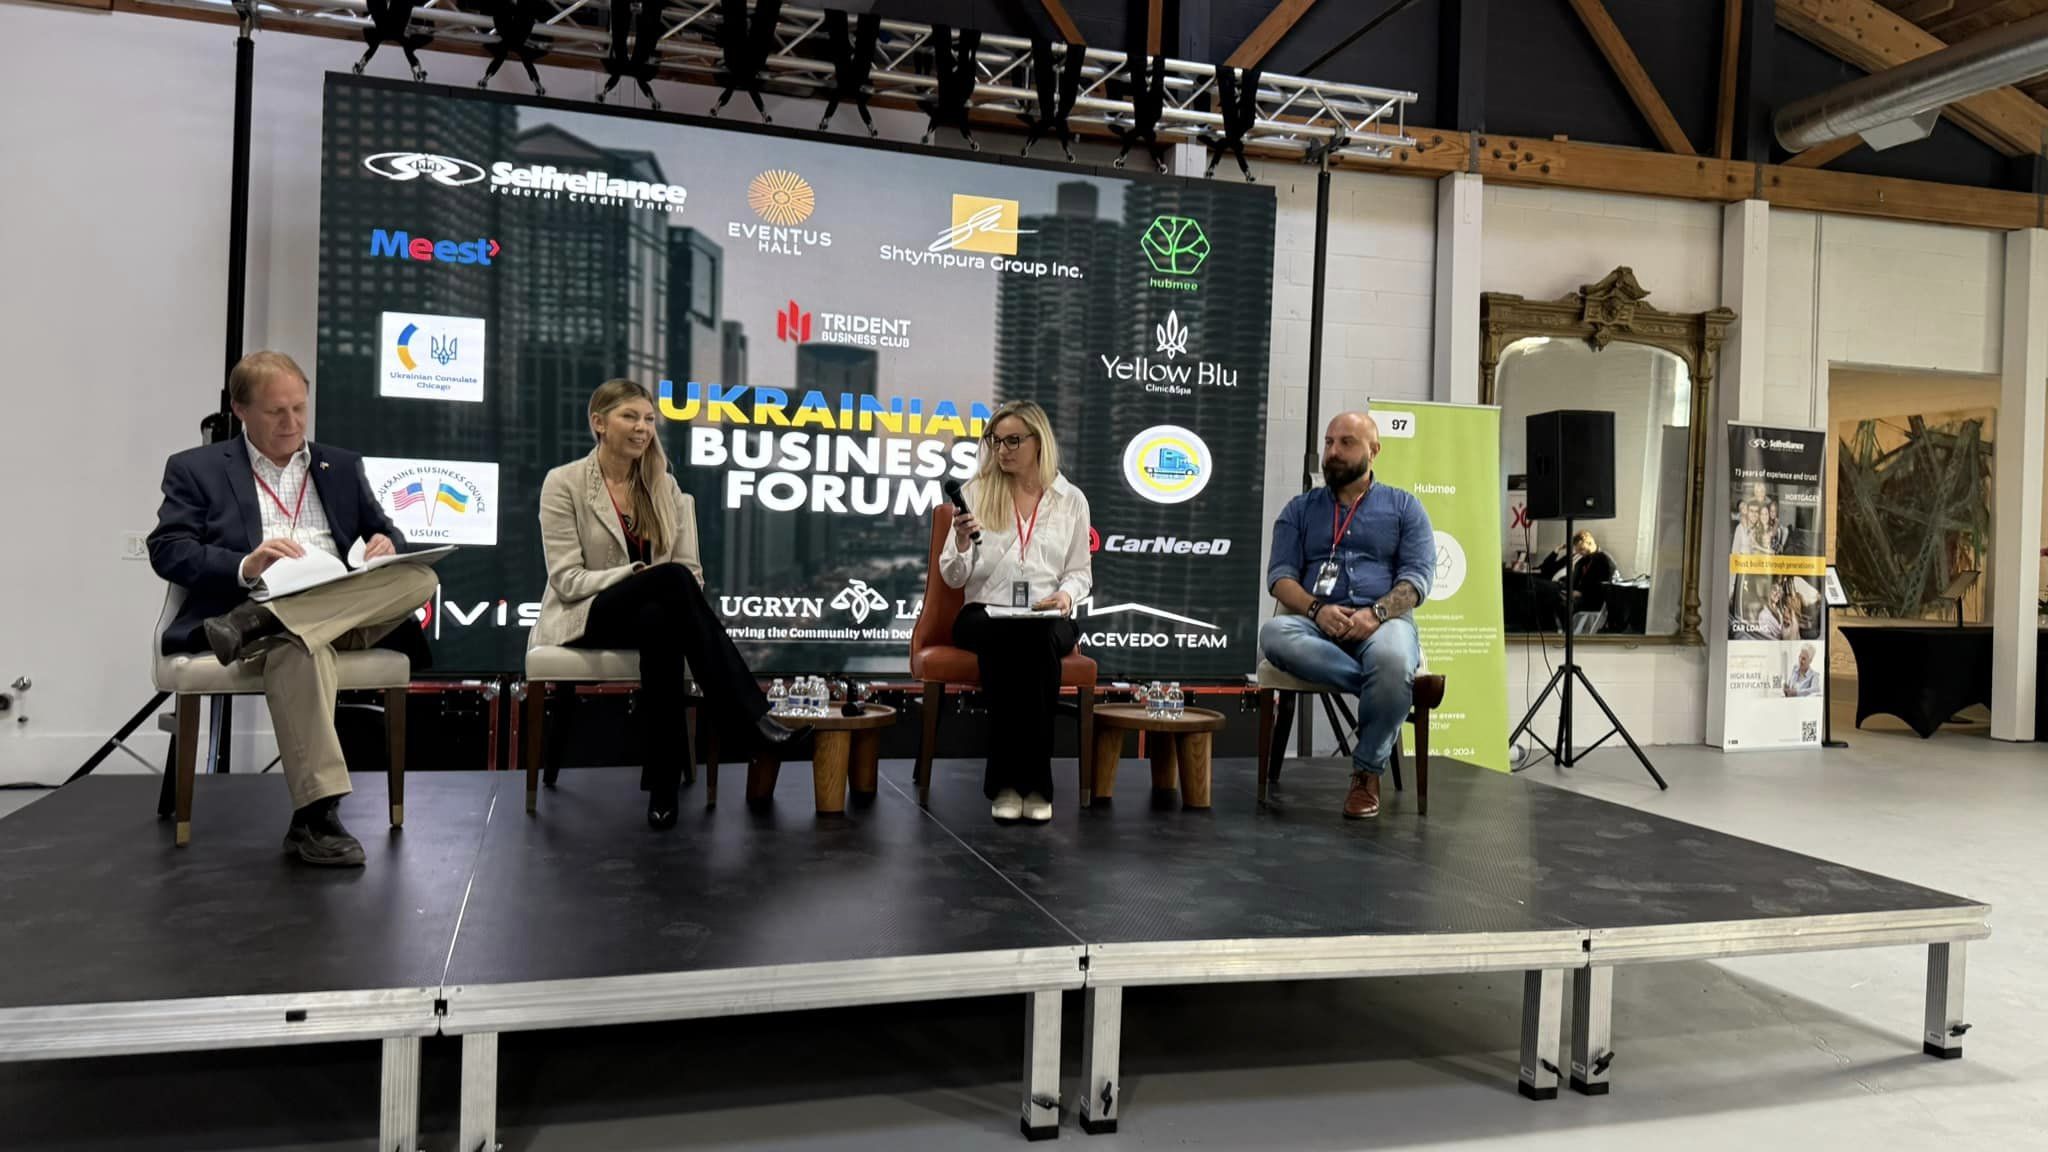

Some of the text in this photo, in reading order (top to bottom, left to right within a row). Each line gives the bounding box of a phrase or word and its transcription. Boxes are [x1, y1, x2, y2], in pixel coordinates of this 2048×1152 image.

[491, 162, 687, 203] Selfreliance
[490, 185, 684, 213] Federal Credit Union
[728, 222, 832, 246] EVENTUS
[370, 229, 493, 266] Meest
[758, 240, 802, 256] HALL
[880, 245, 1083, 279] Shtympura Group Inc.
[1150, 277, 1198, 291] hubmee
[821, 313, 911, 336] TRIDENT
[822, 332, 910, 348] BUSINESS CLUB
[390, 371, 477, 383] Ukrainian Consulate
[1101, 354, 1237, 387] Yellow Blu
[416, 382, 451, 391] Chicago
[1145, 384, 1191, 395] Clinic&Spa
[658, 379, 993, 438] UKRAINIAN
[1392, 419, 1408, 431] 97
[690, 426, 978, 480] BUSINESS
[1742, 469, 1758, 478] years
[1759, 469, 1766, 477] of
[1793, 472, 1803, 480] and
[1804, 473, 1817, 481] trust
[726, 470, 944, 516] FORUM
[1414, 482, 1456, 495] Hubmee
[720, 596, 824, 618] UGRYN
[767, 626, 787, 638] the
[789, 628, 859, 640] Community
[862, 628, 888, 640] With
[1732, 623, 1746, 632] CAR
[1078, 632, 1227, 648] ACEVEDO TEAM
